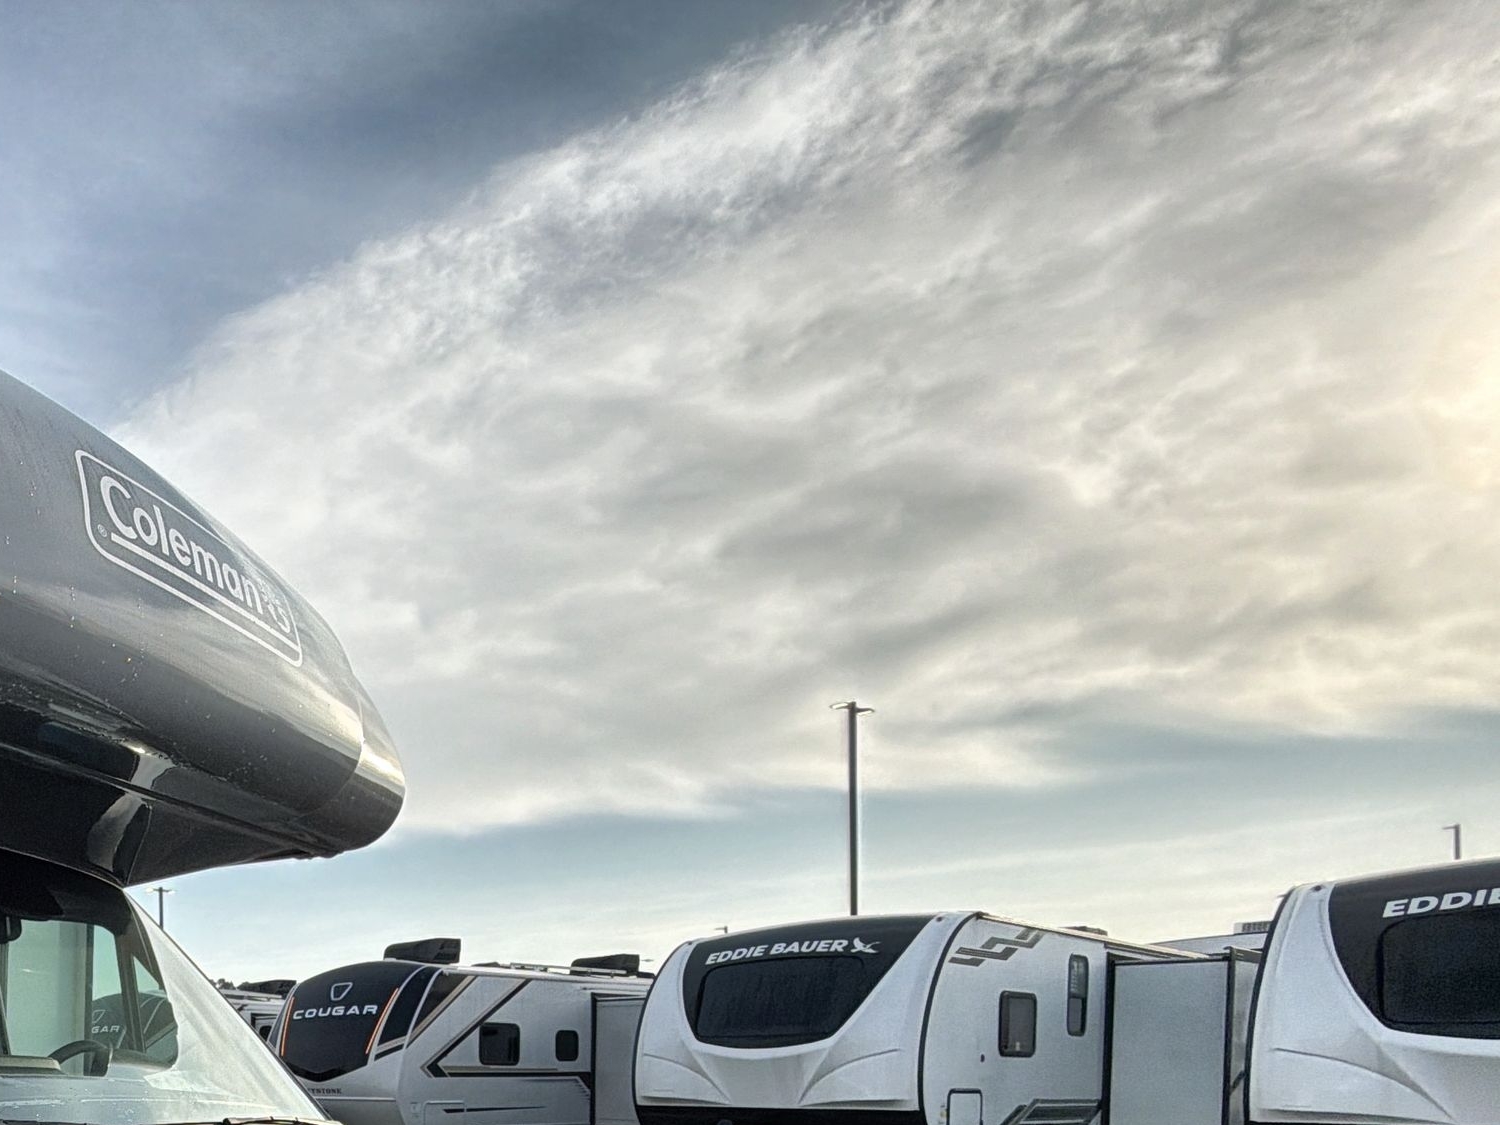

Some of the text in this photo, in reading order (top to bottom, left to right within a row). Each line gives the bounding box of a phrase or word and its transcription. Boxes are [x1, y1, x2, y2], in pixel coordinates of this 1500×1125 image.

[100, 475, 264, 615] Coleman
[705, 939, 849, 965] EDDIE BAUER
[293, 1004, 378, 1020] COUGAR
[91, 1025, 120, 1034] GAR
[308, 1087, 342, 1095] YSTONE
